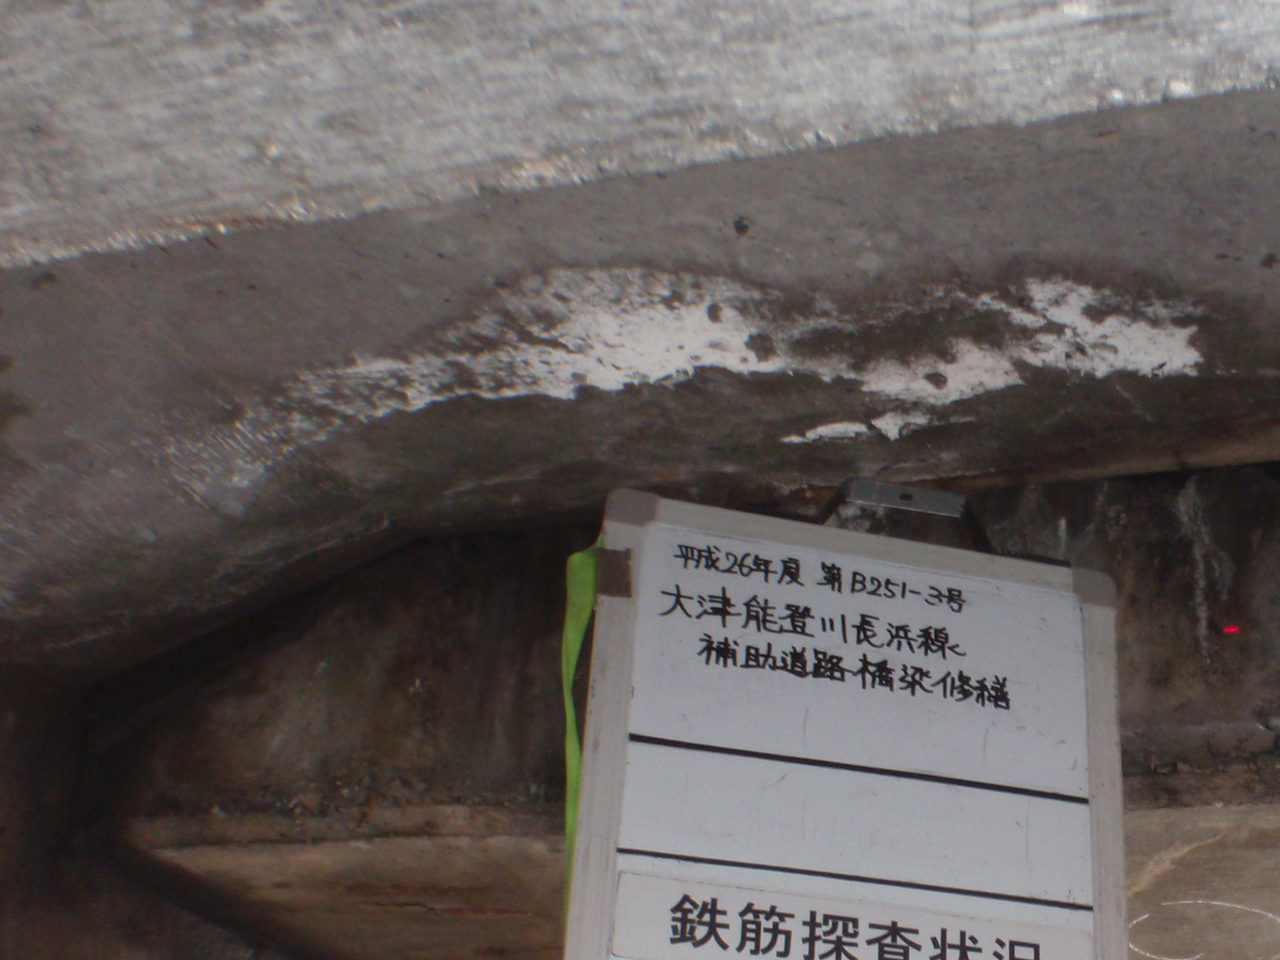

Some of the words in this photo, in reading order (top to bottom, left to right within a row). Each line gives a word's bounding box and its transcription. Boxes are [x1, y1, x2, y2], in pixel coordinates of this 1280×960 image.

[659, 584, 967, 660] 大津能登川長浜線
[697, 633, 1011, 710] 補助道路橋梁修繕
